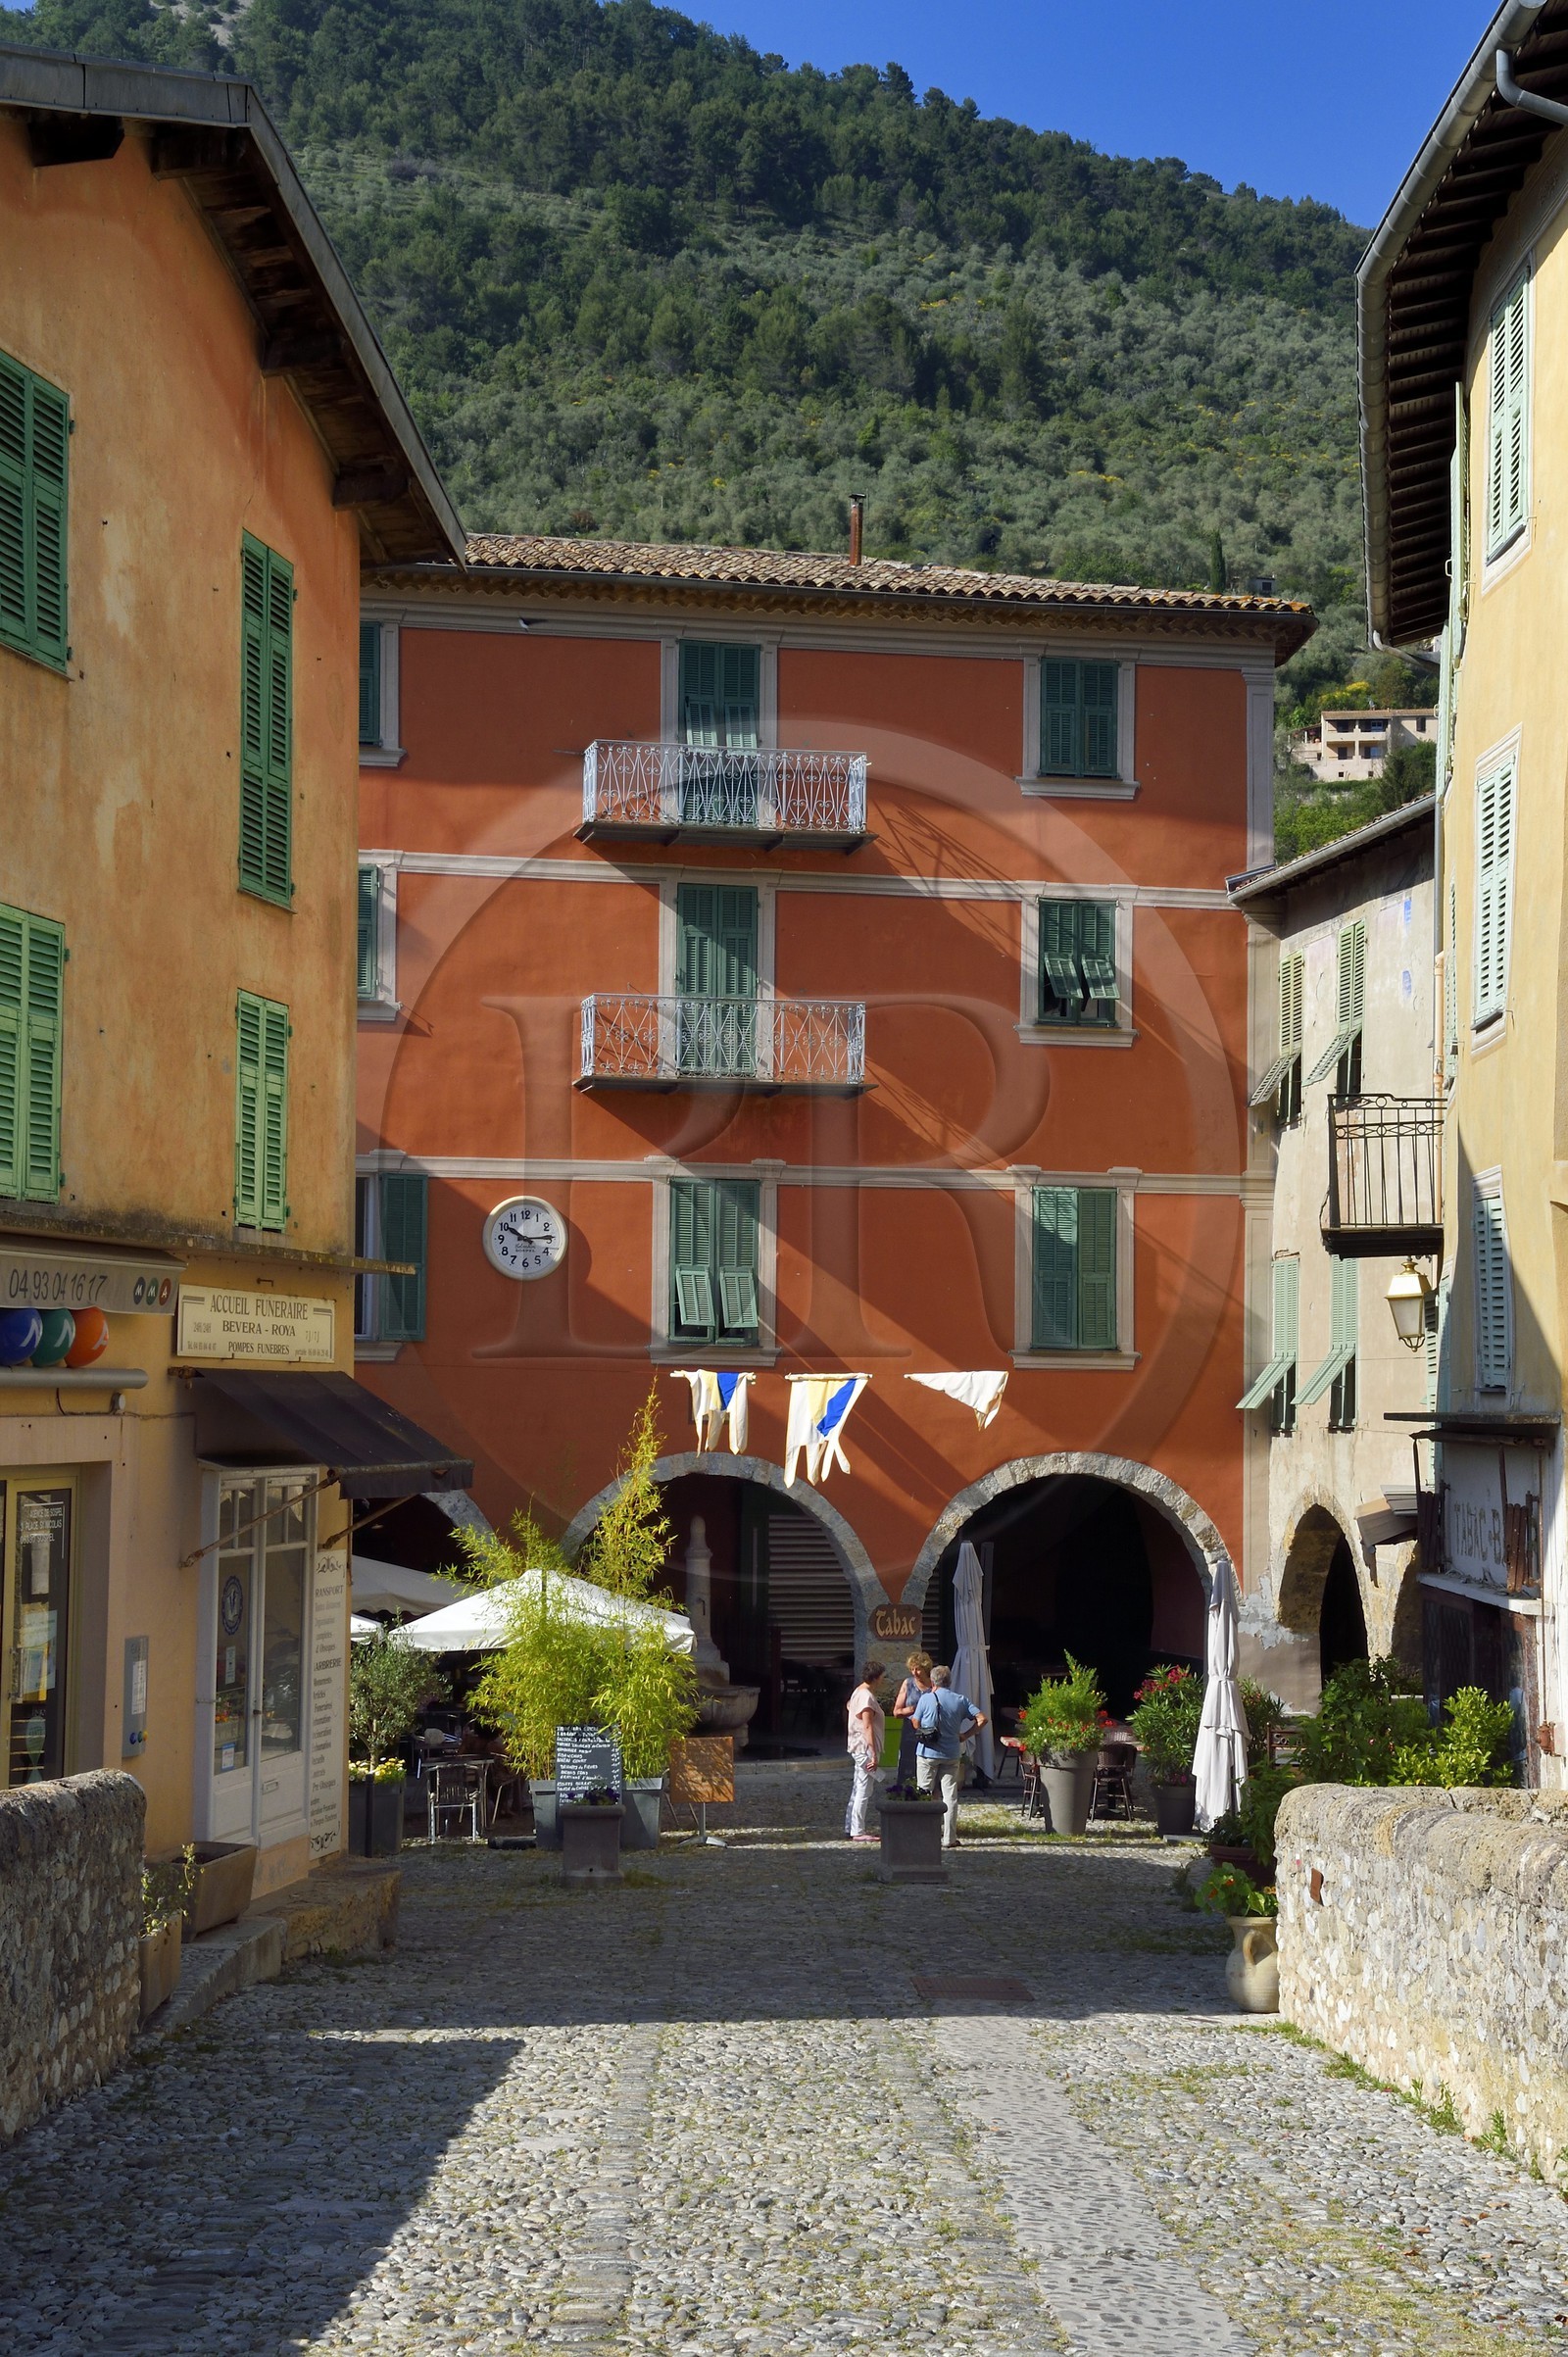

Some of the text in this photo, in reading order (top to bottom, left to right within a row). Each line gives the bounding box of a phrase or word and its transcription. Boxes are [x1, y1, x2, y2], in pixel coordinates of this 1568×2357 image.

[510, 1213, 516, 1222] 11
[521, 1210, 531, 1219] 12
[500, 1222, 509, 1231] 10
[543, 1222, 550, 1231] 2
[498, 1234, 505, 1245] 9
[502, 1247, 509, 1255] 8
[511, 1255, 516, 1264] 7
[522, 1257, 529, 1267] 6
[534, 1255, 541, 1264] 5
[9, 1268, 109, 1301] 04 93 04 16 17
[210, 1294, 309, 1320] ACCUEIL FUNERAIRE
[222, 1320, 263, 1335] BEVERA
[271, 1324, 296, 1337] ROYA
[228, 1342, 290, 1355] POMPES FUNEBRES
[50, 1507, 63, 1517] SOSPEL
[25, 1521, 38, 1531] PLACE
[1454, 1500, 1488, 1561] TABAC
[315, 1585, 344, 1597] RANSPORT
[875, 1608, 916, 1637] Tabac
